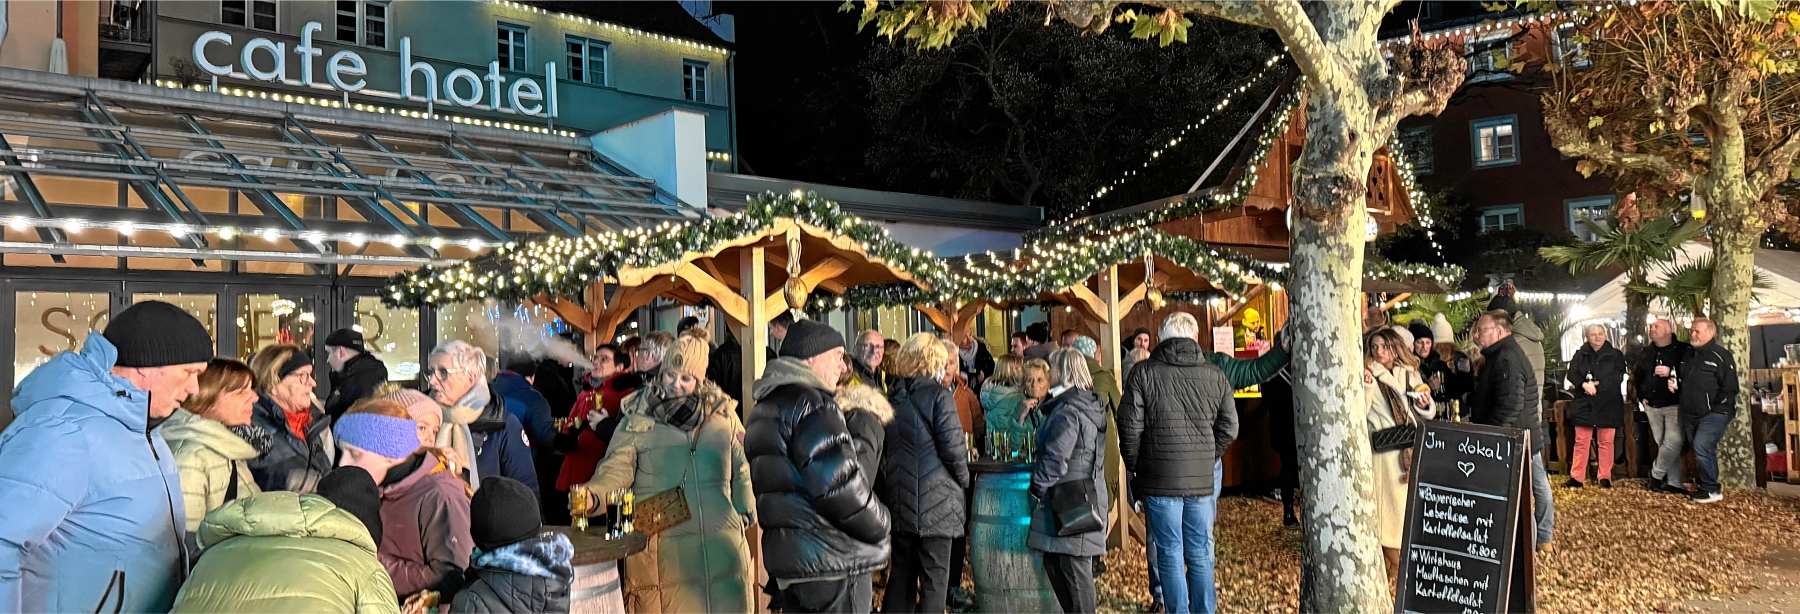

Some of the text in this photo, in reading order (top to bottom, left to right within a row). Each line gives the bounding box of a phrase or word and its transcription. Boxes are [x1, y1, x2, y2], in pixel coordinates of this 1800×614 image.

[192, 21, 558, 118] cafe hotel
[1423, 519, 1489, 545] Kartoffelsalat
[1476, 512, 1494, 528] mit
[1416, 580, 1484, 609] Kartoffelsalat
[1473, 574, 1490, 591] mit
